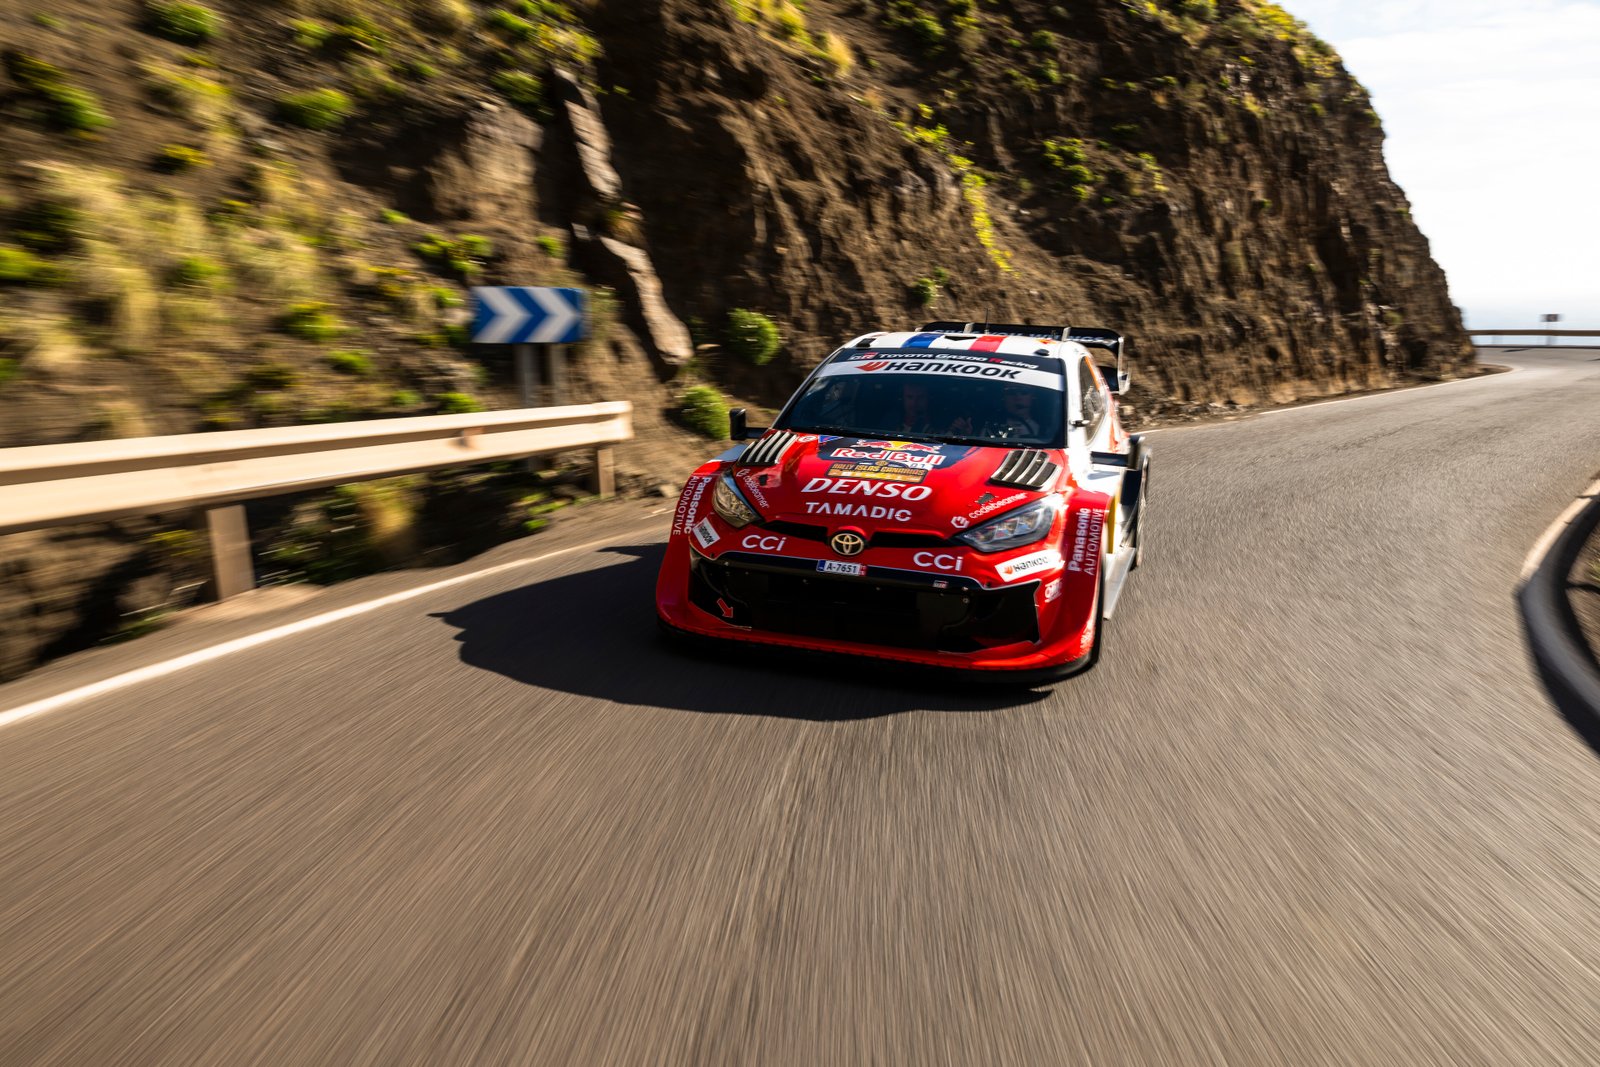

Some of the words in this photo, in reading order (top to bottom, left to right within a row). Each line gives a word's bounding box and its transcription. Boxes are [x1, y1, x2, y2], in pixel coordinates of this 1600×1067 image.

[988, 357, 1039, 370] Racing
[830, 448, 891, 461] Red
[886, 451, 946, 466] Bull
[801, 477, 933, 501] DENSO
[672, 475, 700, 536] AUTOMOTIVE
[683, 477, 713, 535] Panasonic
[805, 502, 913, 522] TAMADIC
[1067, 507, 1092, 573] Panasonic
[1083, 508, 1105, 576] AUTOMOTIVE
[826, 562, 858, 573] A-7651
